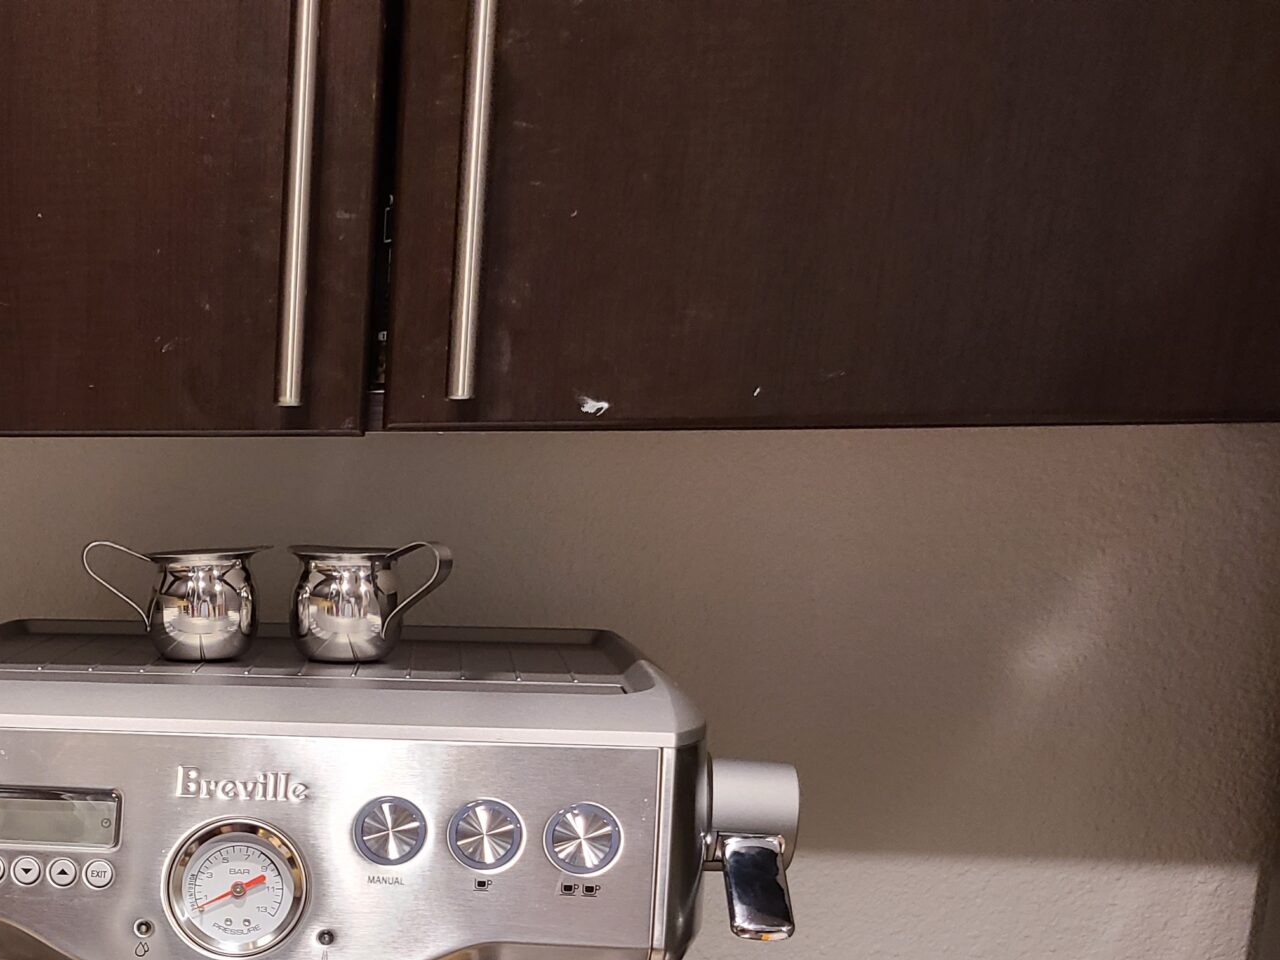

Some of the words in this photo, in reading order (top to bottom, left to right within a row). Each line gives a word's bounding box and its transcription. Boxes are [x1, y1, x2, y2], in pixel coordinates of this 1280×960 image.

[175, 765, 310, 803] Breville
[90, 869, 107, 879] EXIT
[260, 865, 268, 873] 9
[205, 871, 214, 879] 3
[367, 875, 405, 886] MANUAL
[256, 905, 268, 913] 13
[212, 923, 262, 936] PRESSURE
